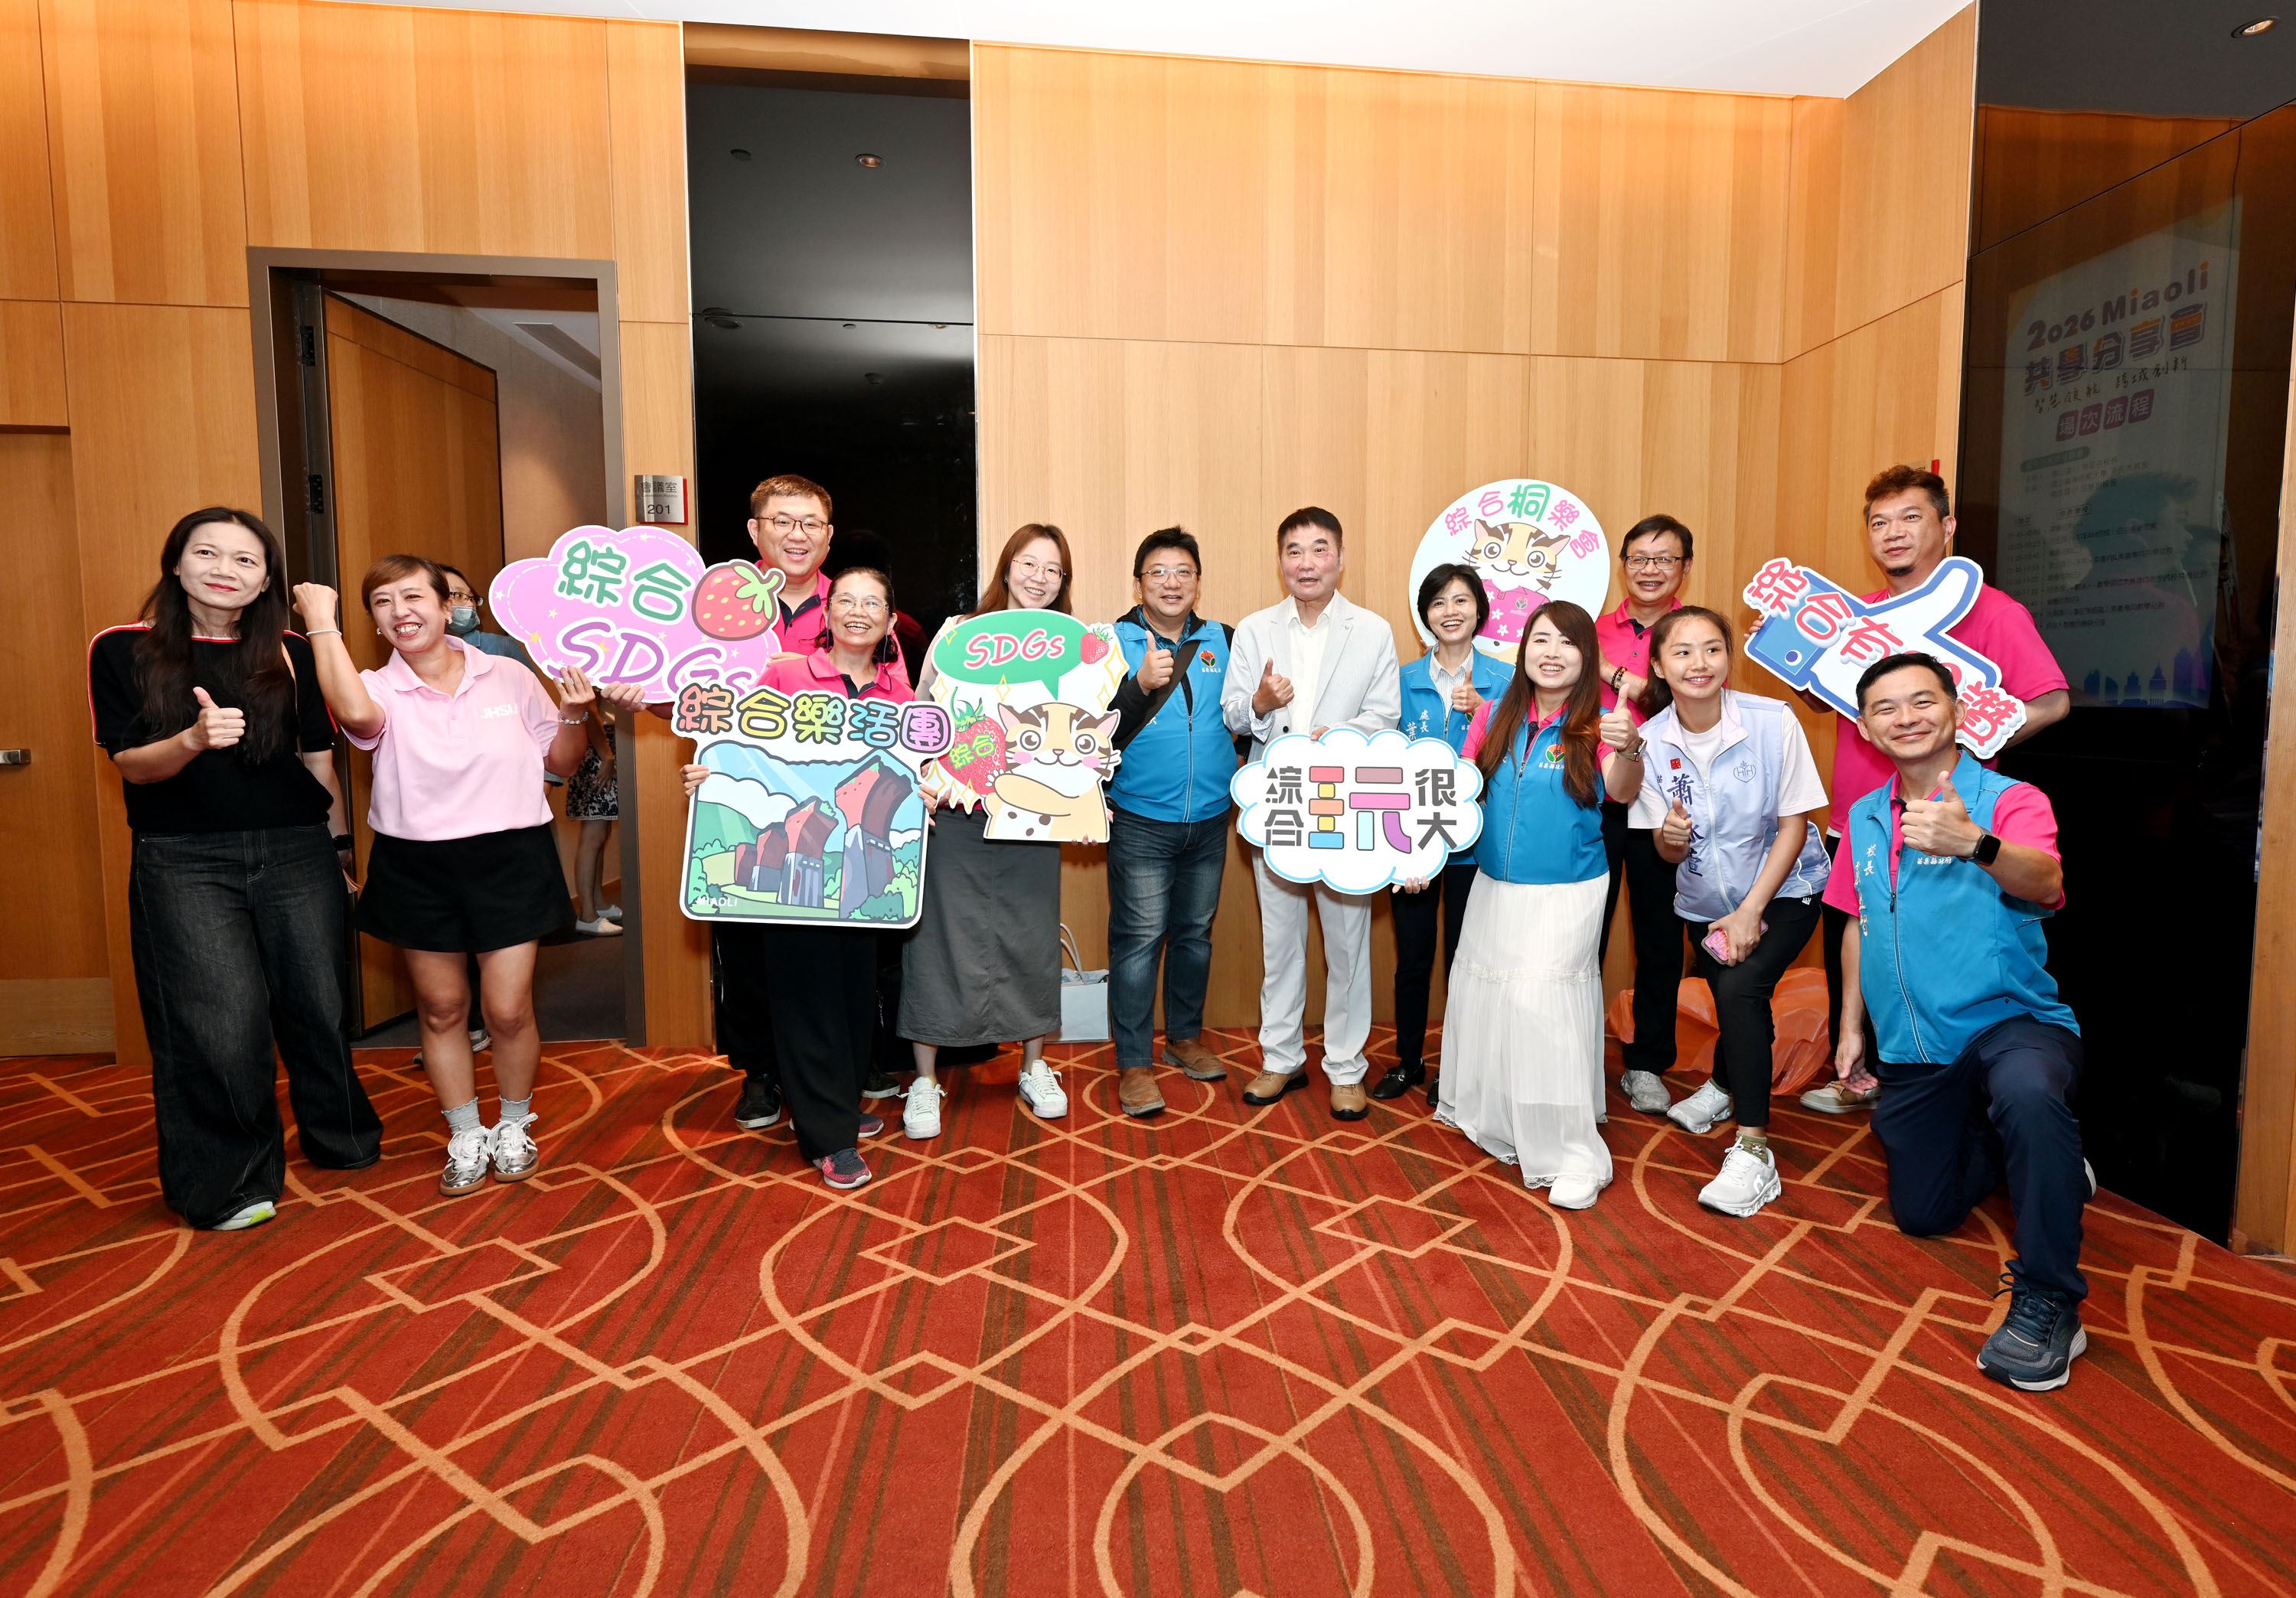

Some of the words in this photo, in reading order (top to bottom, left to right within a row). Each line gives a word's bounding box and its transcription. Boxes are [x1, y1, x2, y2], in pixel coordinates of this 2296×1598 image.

[2027, 308, 2095, 351] 2026
[2102, 261, 2209, 325] Miaoli
[2060, 397, 2150, 435] 場次流程
[641, 481, 677, 493] 會議室
[647, 504, 670, 514] 201
[558, 540, 691, 621] 綜合
[965, 630, 1065, 667] SDGs
[1747, 560, 2018, 746] 綜合有讚
[677, 683, 951, 753] 綜合樂活團
[949, 734, 995, 769] 綜合
